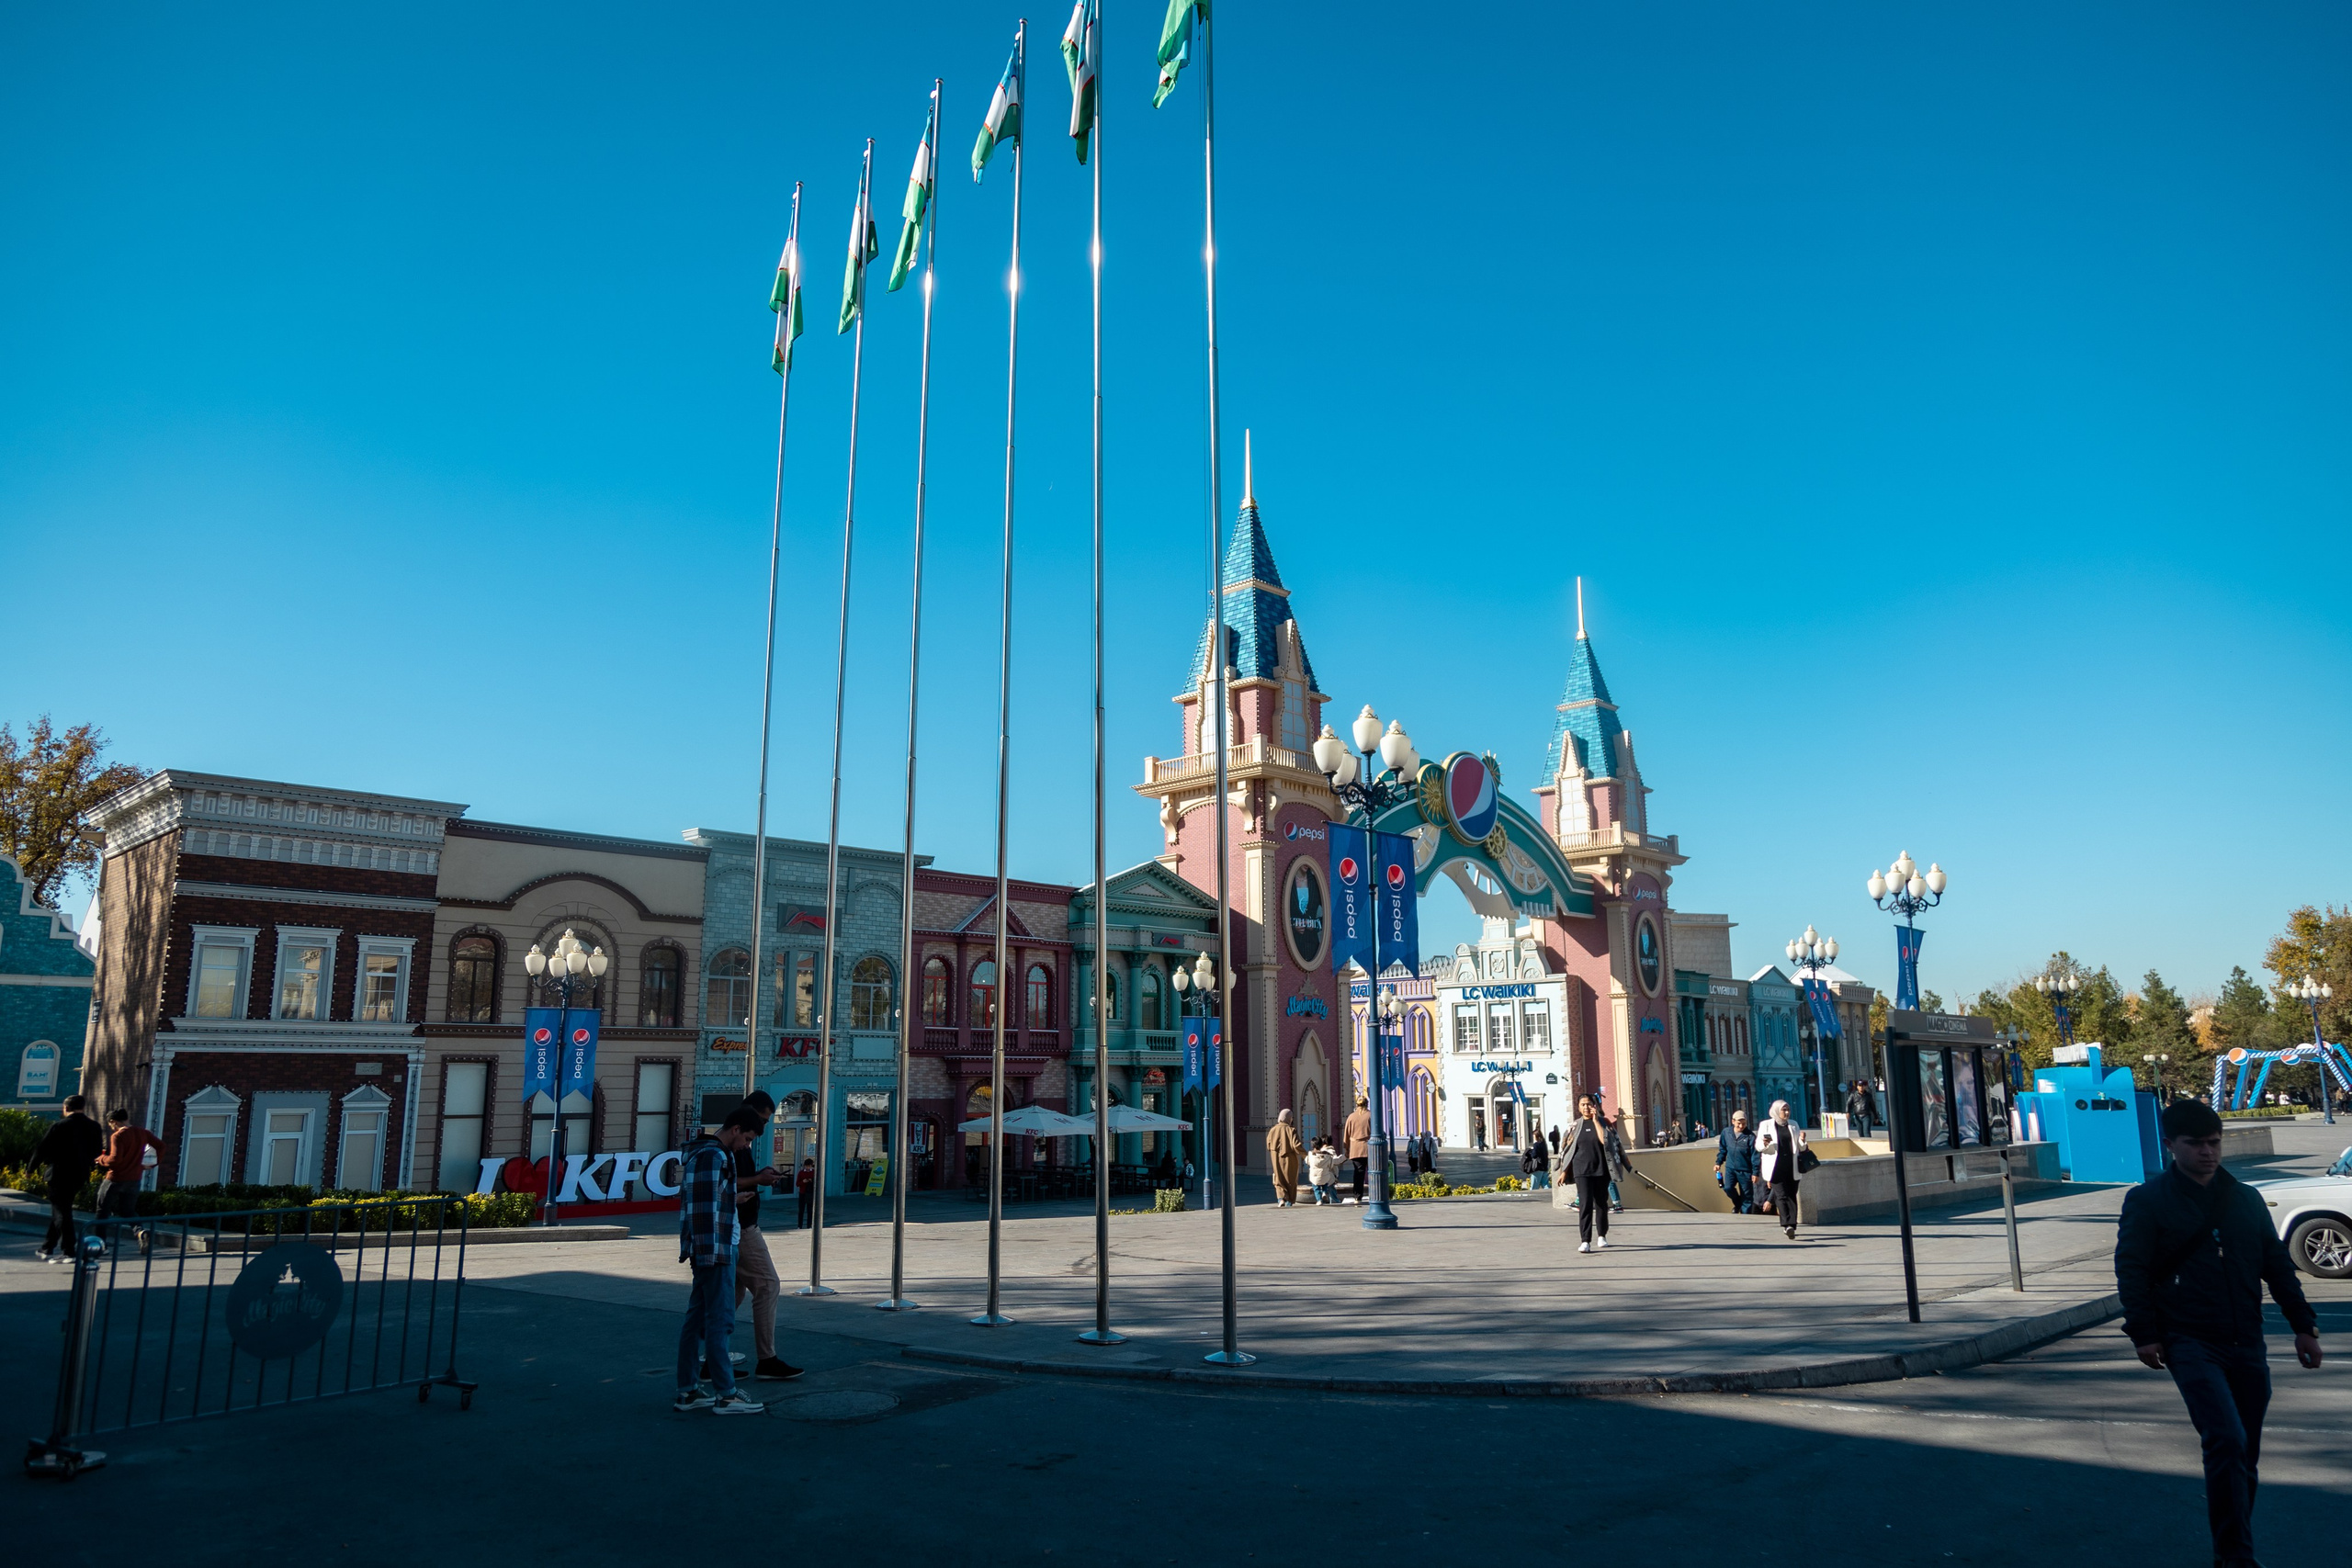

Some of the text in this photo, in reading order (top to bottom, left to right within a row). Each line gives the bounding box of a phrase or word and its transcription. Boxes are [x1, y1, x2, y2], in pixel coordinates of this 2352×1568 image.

[1298, 827, 1325, 841] pepsi
[1344, 888, 1358, 939] pepsi
[1390, 894, 1404, 942] pepsi
[1462, 987, 1480, 1000] LC
[711, 1036, 748, 1054] Expres
[778, 1036, 836, 1057] KFC
[536, 1048, 548, 1078] pepsi
[573, 1048, 585, 1078] pepsi
[476, 1150, 684, 1202] I KFC
